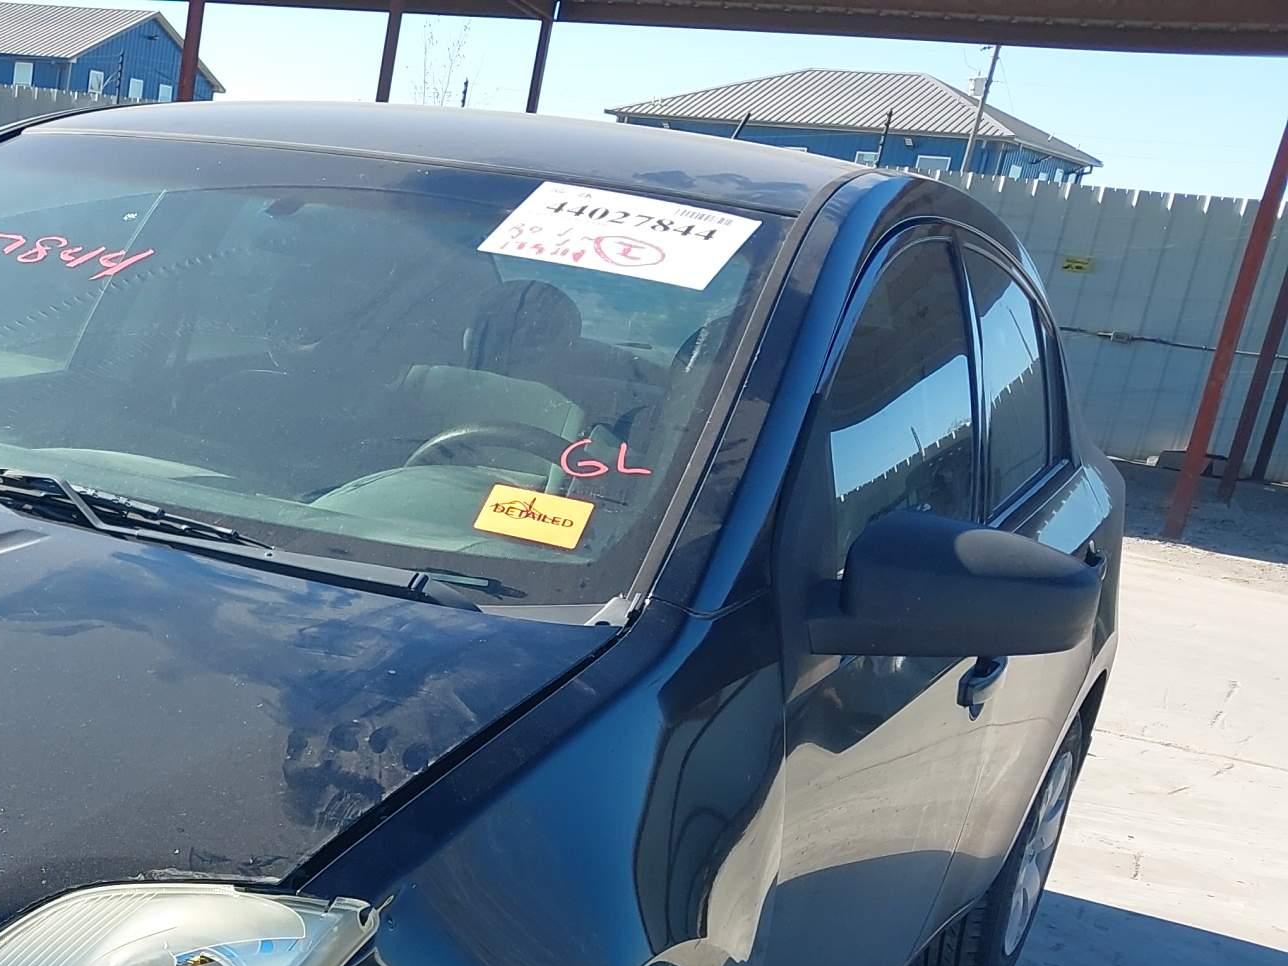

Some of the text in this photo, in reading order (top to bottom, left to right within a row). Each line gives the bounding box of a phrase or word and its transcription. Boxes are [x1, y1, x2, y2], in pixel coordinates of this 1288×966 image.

[546, 201, 718, 241] 44027844
[560, 437, 652, 477] GL
[492, 502, 575, 529] DETAILED
